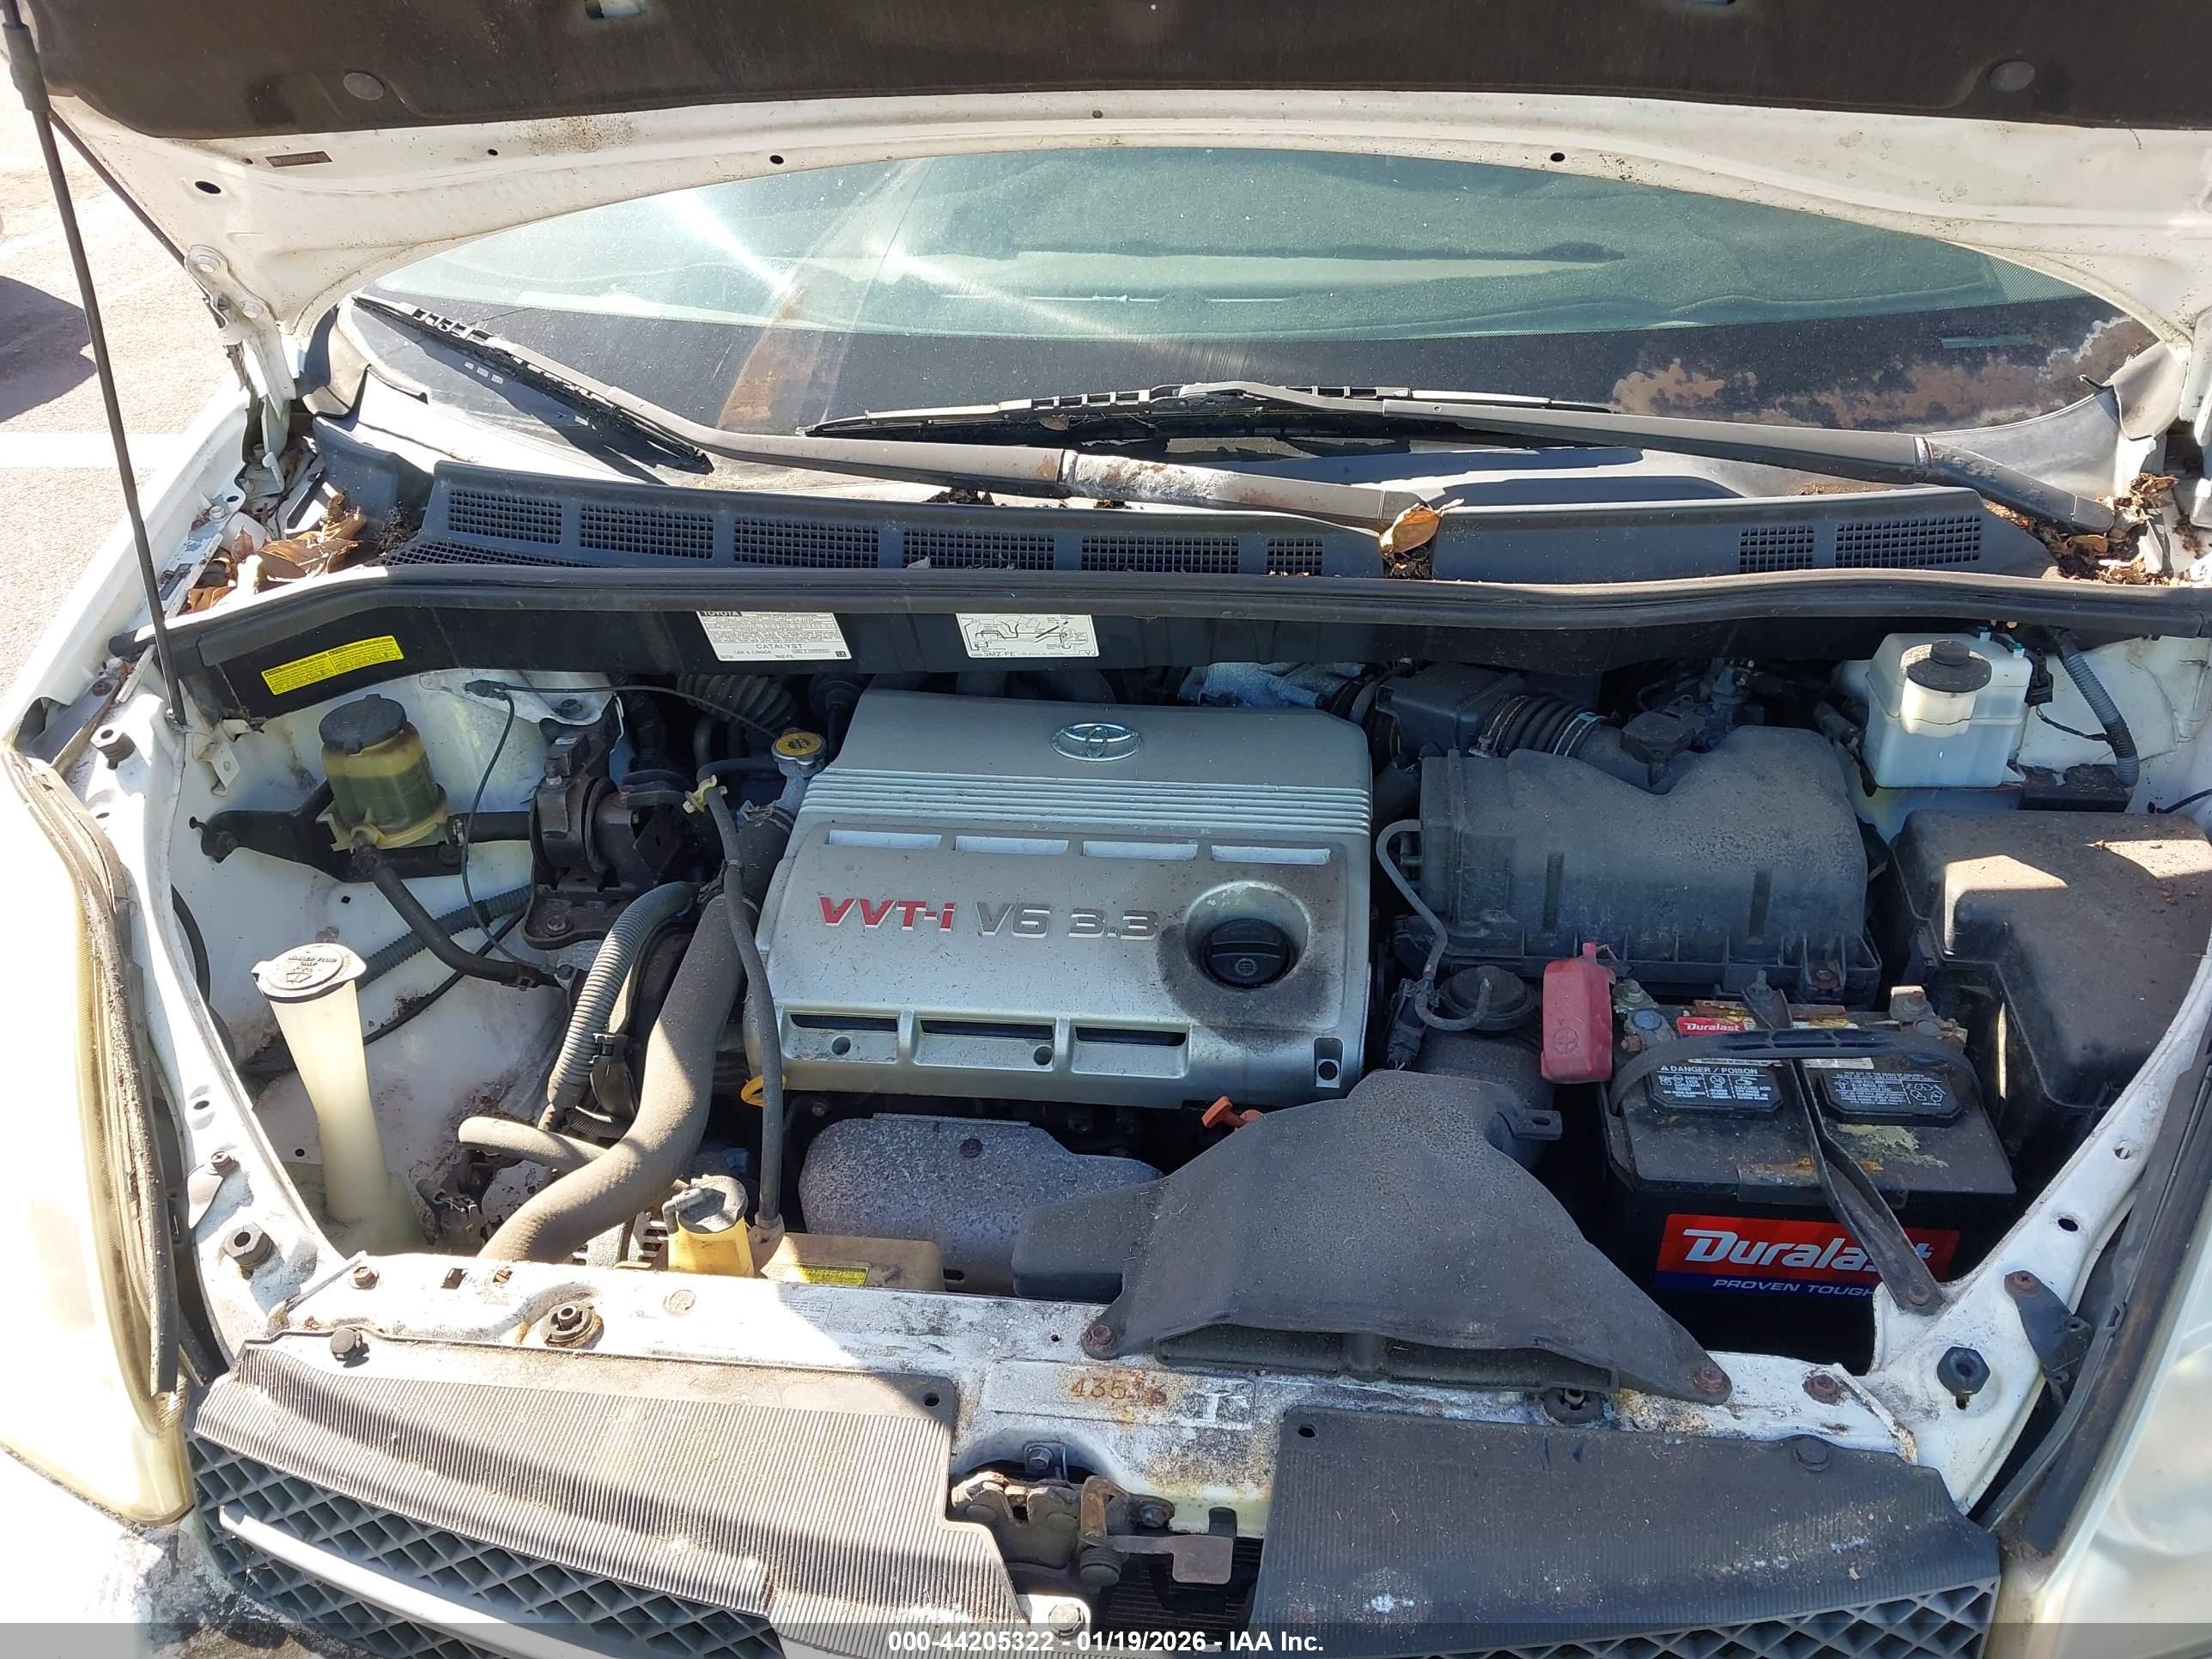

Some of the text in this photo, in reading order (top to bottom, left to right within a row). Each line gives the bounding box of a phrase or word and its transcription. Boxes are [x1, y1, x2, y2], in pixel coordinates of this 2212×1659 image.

[819, 896, 1159, 941] VVT-i V6 3.3
[1684, 1022, 1741, 1030] Duralast
[1682, 1229, 1933, 1273] Duralat
[1713, 1278, 1802, 1291] PROVEN
